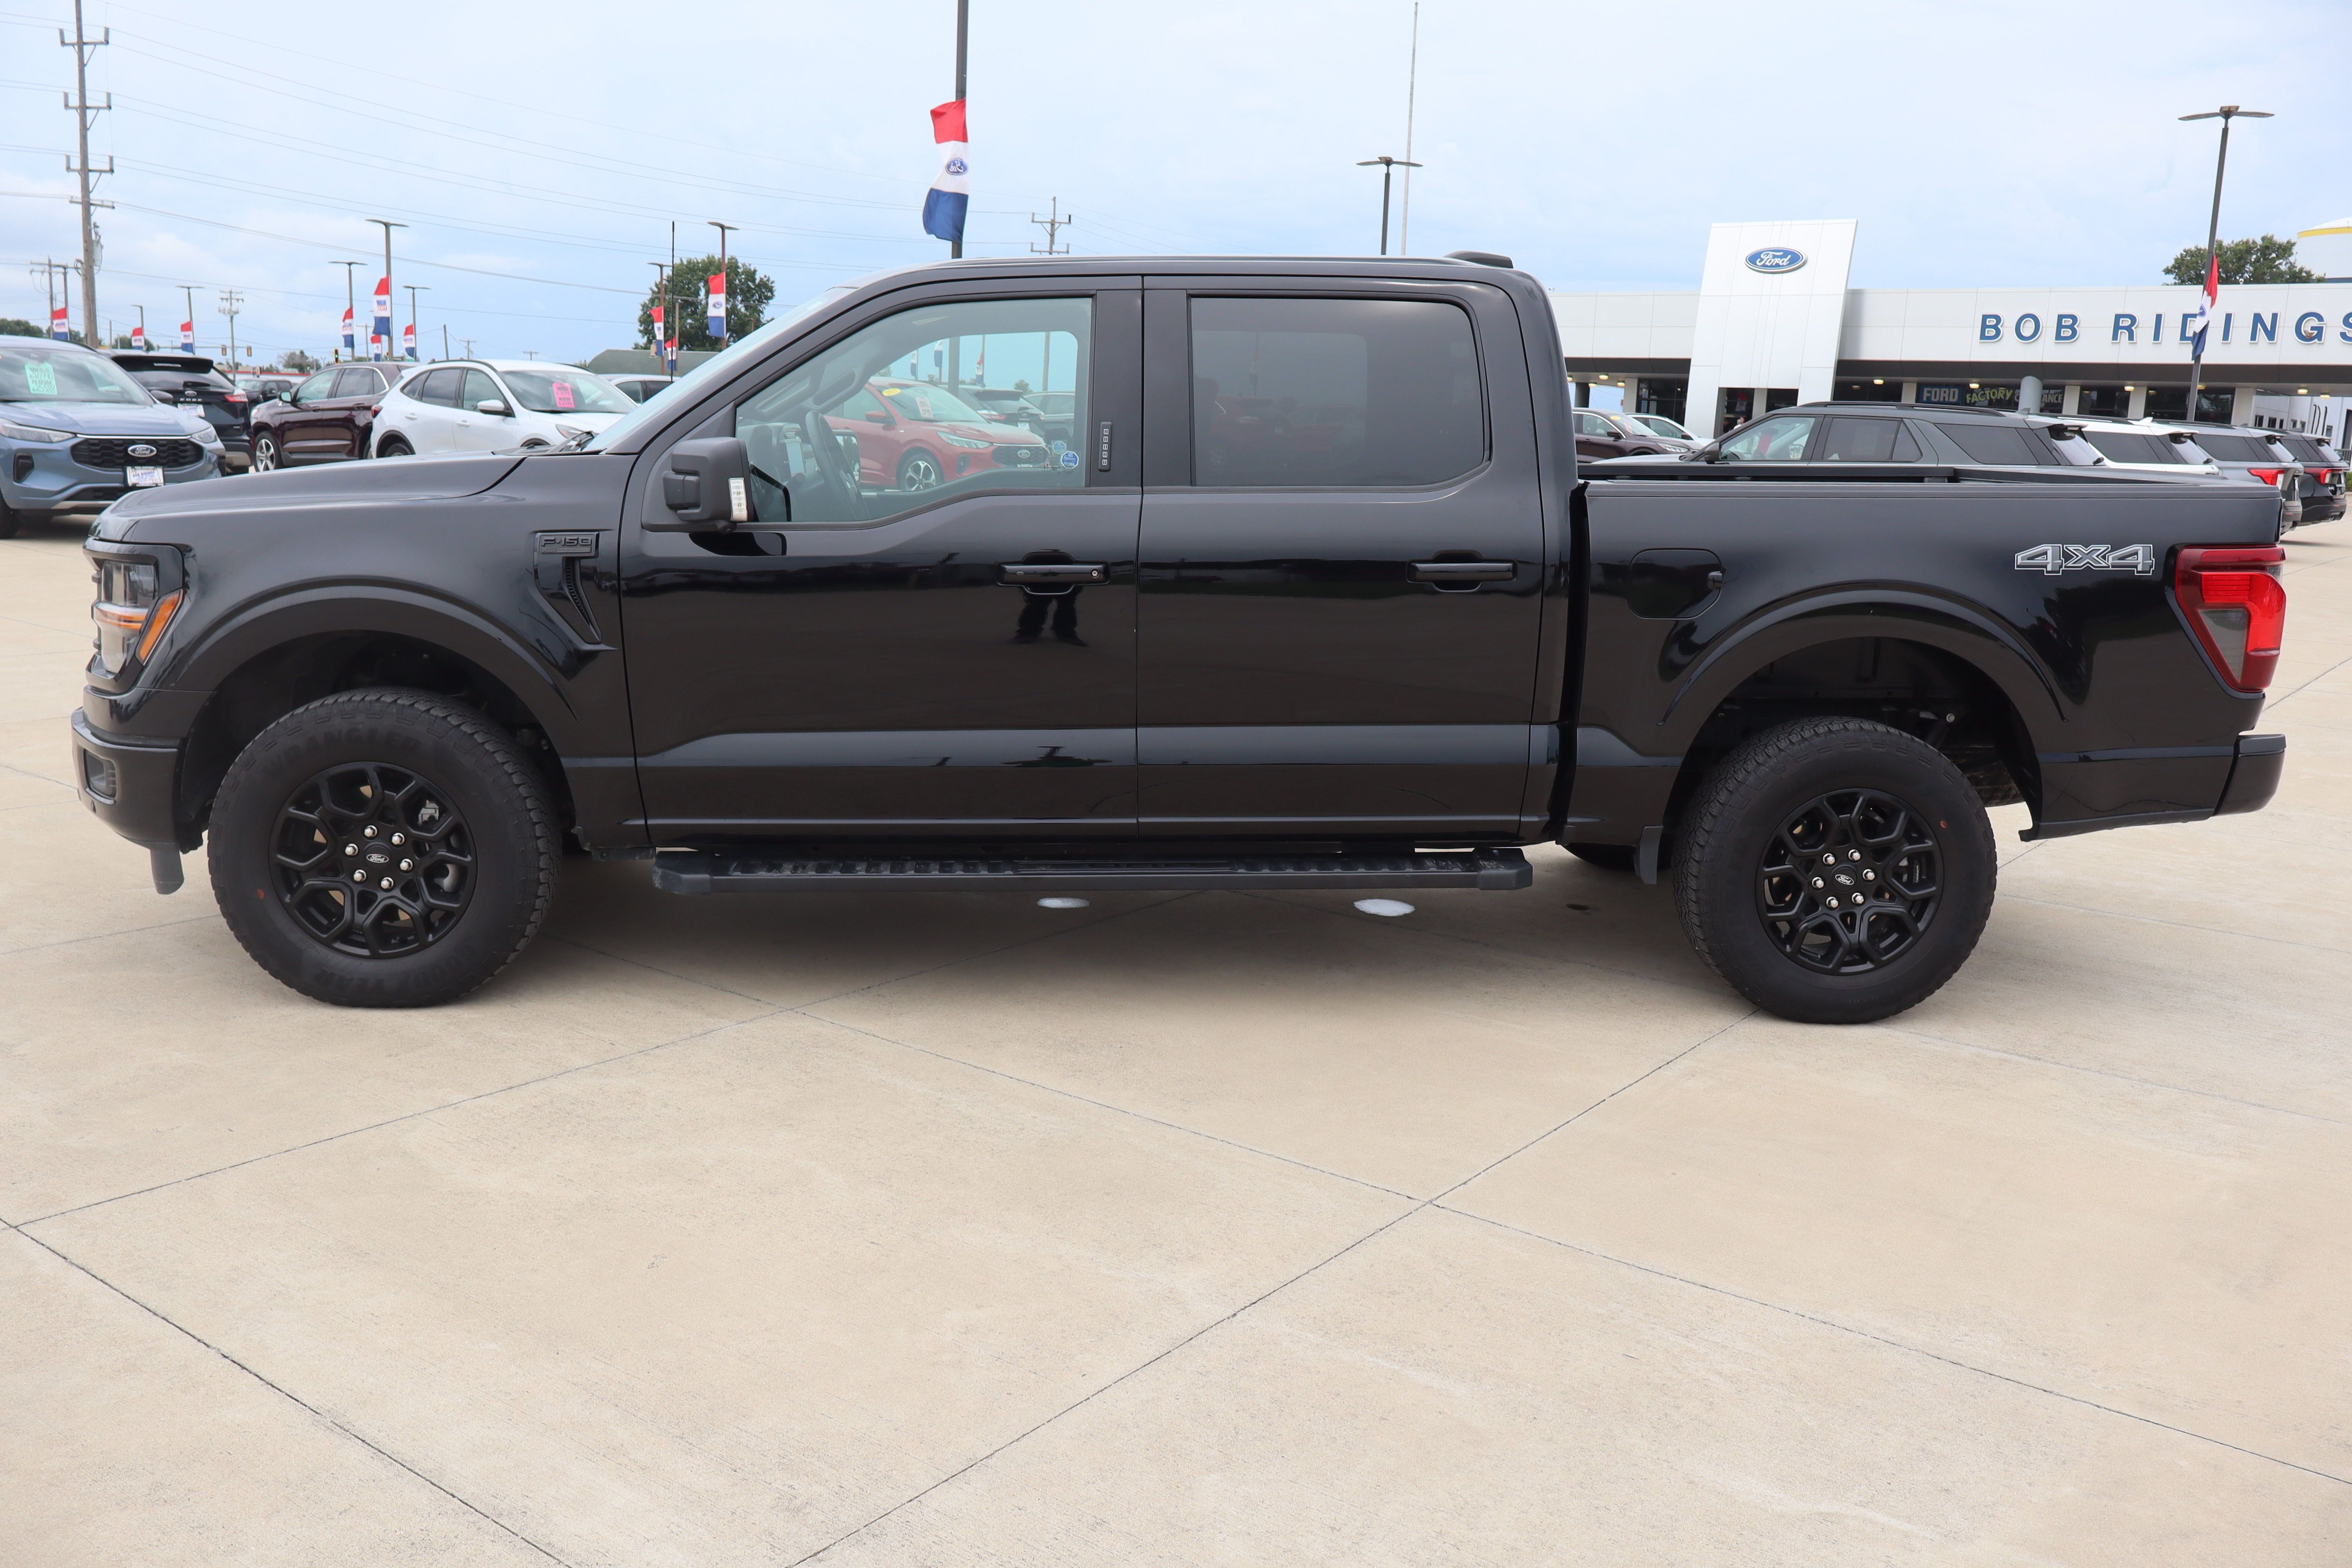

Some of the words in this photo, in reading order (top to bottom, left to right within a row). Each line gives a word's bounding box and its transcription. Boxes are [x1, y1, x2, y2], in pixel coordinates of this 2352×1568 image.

[1756, 251, 1791, 266] Ford
[1979, 313, 2080, 343] BOB
[1923, 388, 1959, 403] FORD
[1966, 389, 2013, 403] FACTORY
[541, 537, 592, 546] F-150
